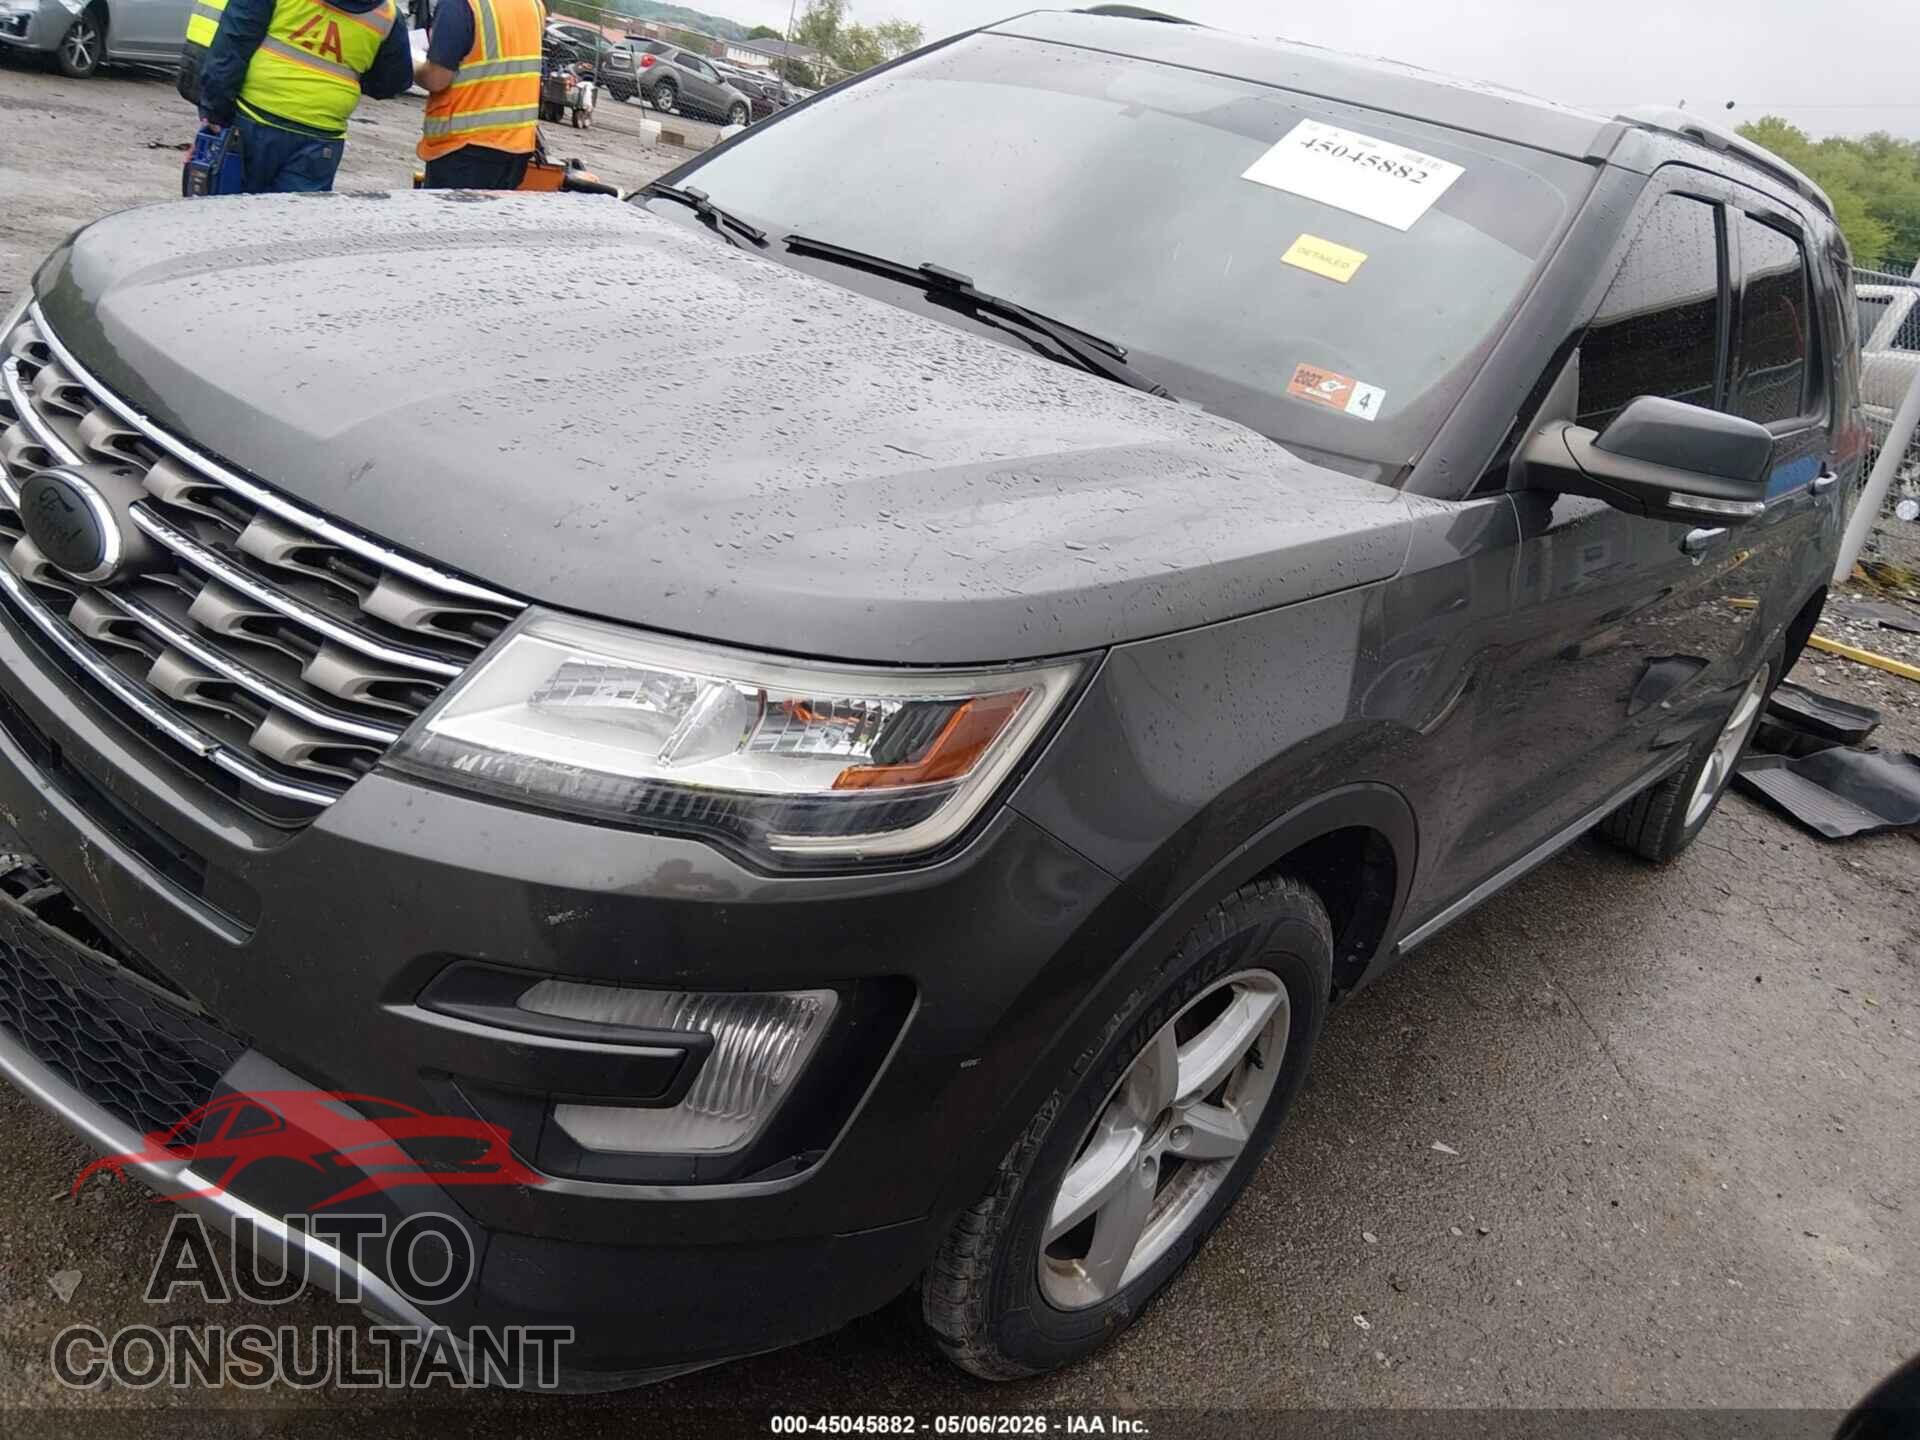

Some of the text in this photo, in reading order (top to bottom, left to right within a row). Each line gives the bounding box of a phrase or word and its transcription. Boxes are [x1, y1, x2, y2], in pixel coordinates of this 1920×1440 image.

[1301, 138, 1428, 184] 45045882
[1296, 246, 1350, 269] DETAILED
[1359, 393, 1372, 411] 4
